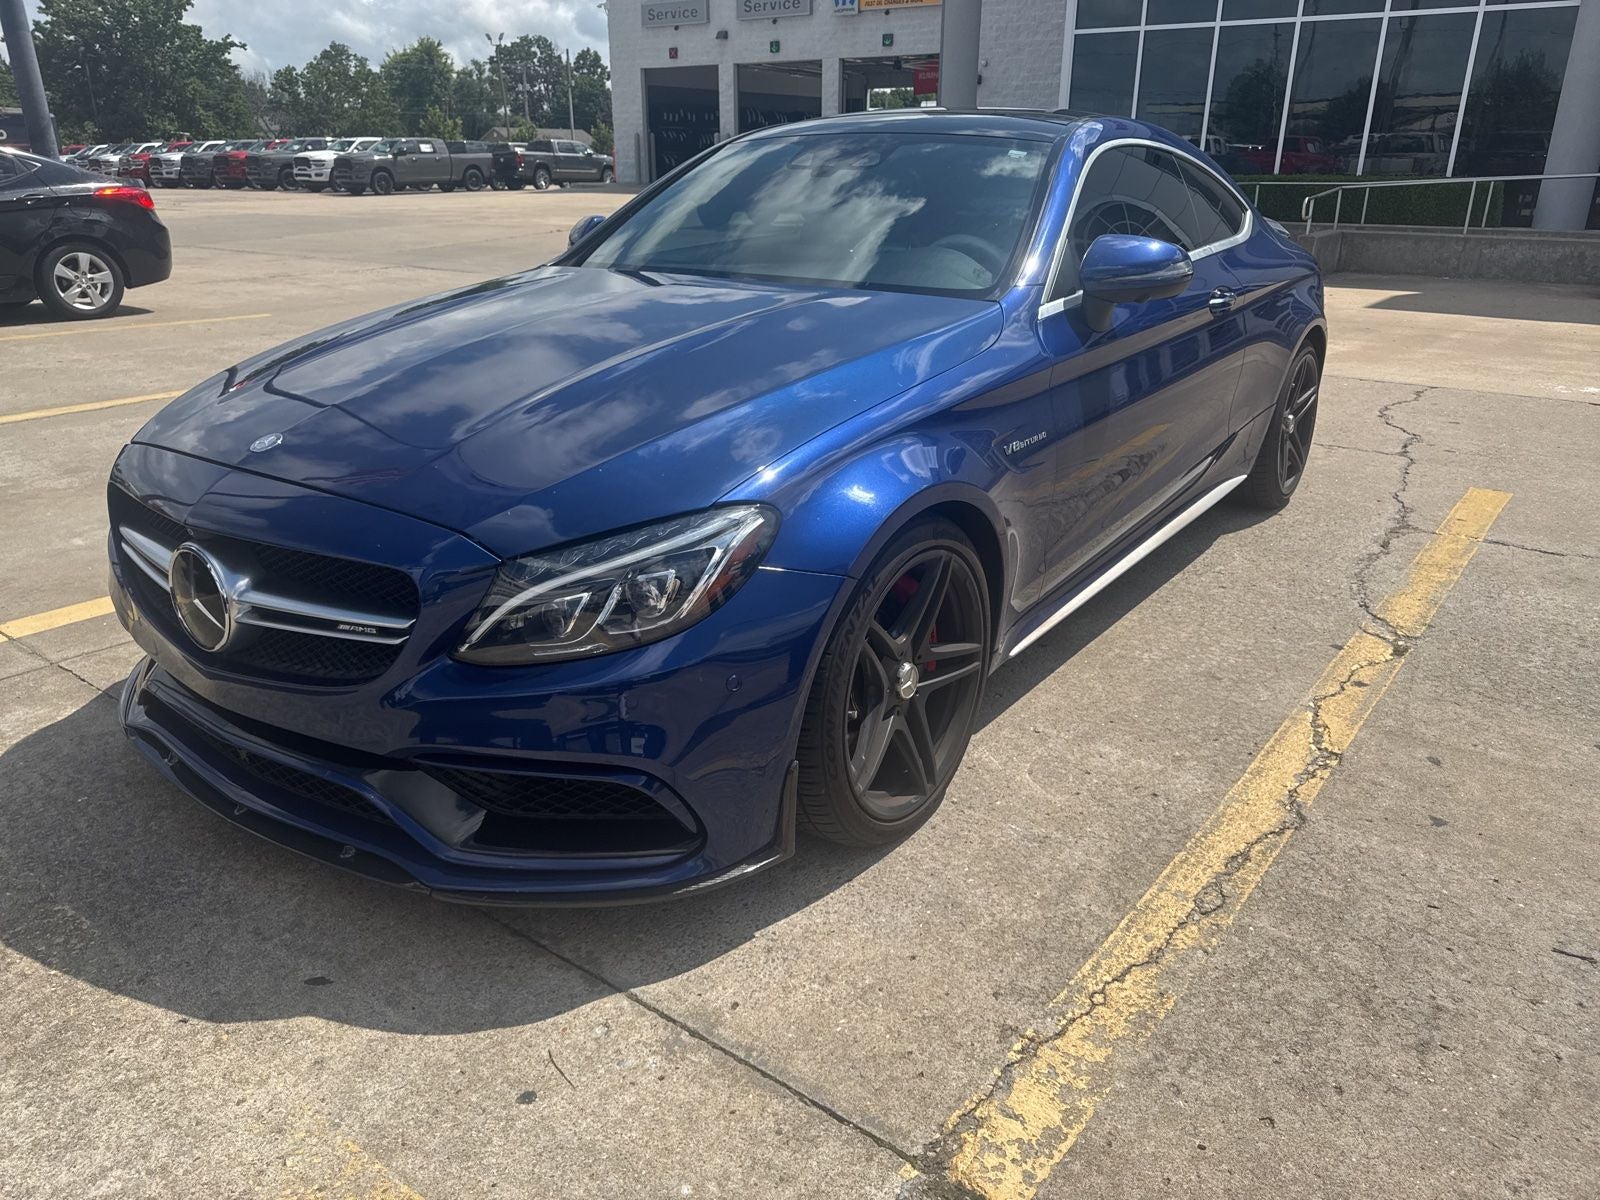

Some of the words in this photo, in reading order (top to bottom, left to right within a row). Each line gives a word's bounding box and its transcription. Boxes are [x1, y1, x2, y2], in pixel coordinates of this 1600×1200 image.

[743, 0, 801, 13] Service
[647, 7, 698, 21] Service
[348, 625, 377, 634] AMG
